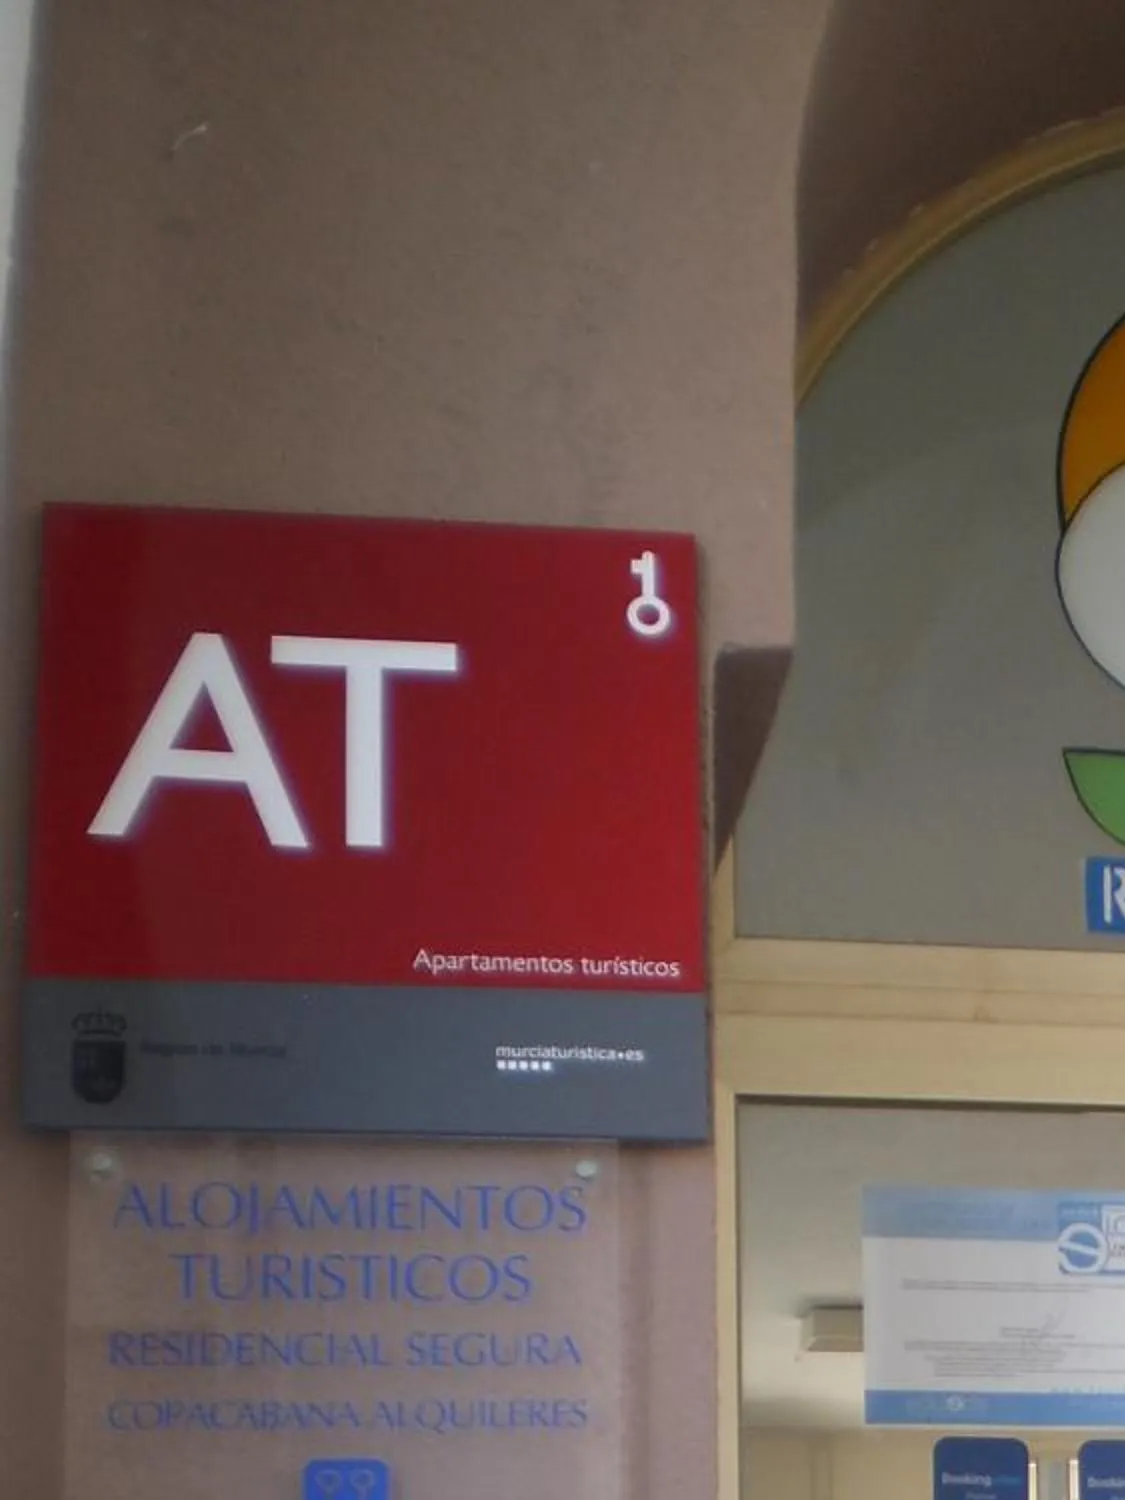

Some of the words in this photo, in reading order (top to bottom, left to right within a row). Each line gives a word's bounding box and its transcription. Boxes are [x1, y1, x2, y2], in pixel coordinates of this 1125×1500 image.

[87, 632, 458, 849] AT
[413, 948, 574, 980] Apartamentos
[580, 954, 681, 978] turísticos
[113, 1181, 588, 1234] ALOJAMIENTOS
[169, 1252, 533, 1302] TURISTICOS
[110, 1331, 390, 1368] RESIDENCIAL
[407, 1331, 581, 1367] SEGURA
[108, 1400, 360, 1431] COPACABANA
[375, 1400, 588, 1435] ALQUILERES
